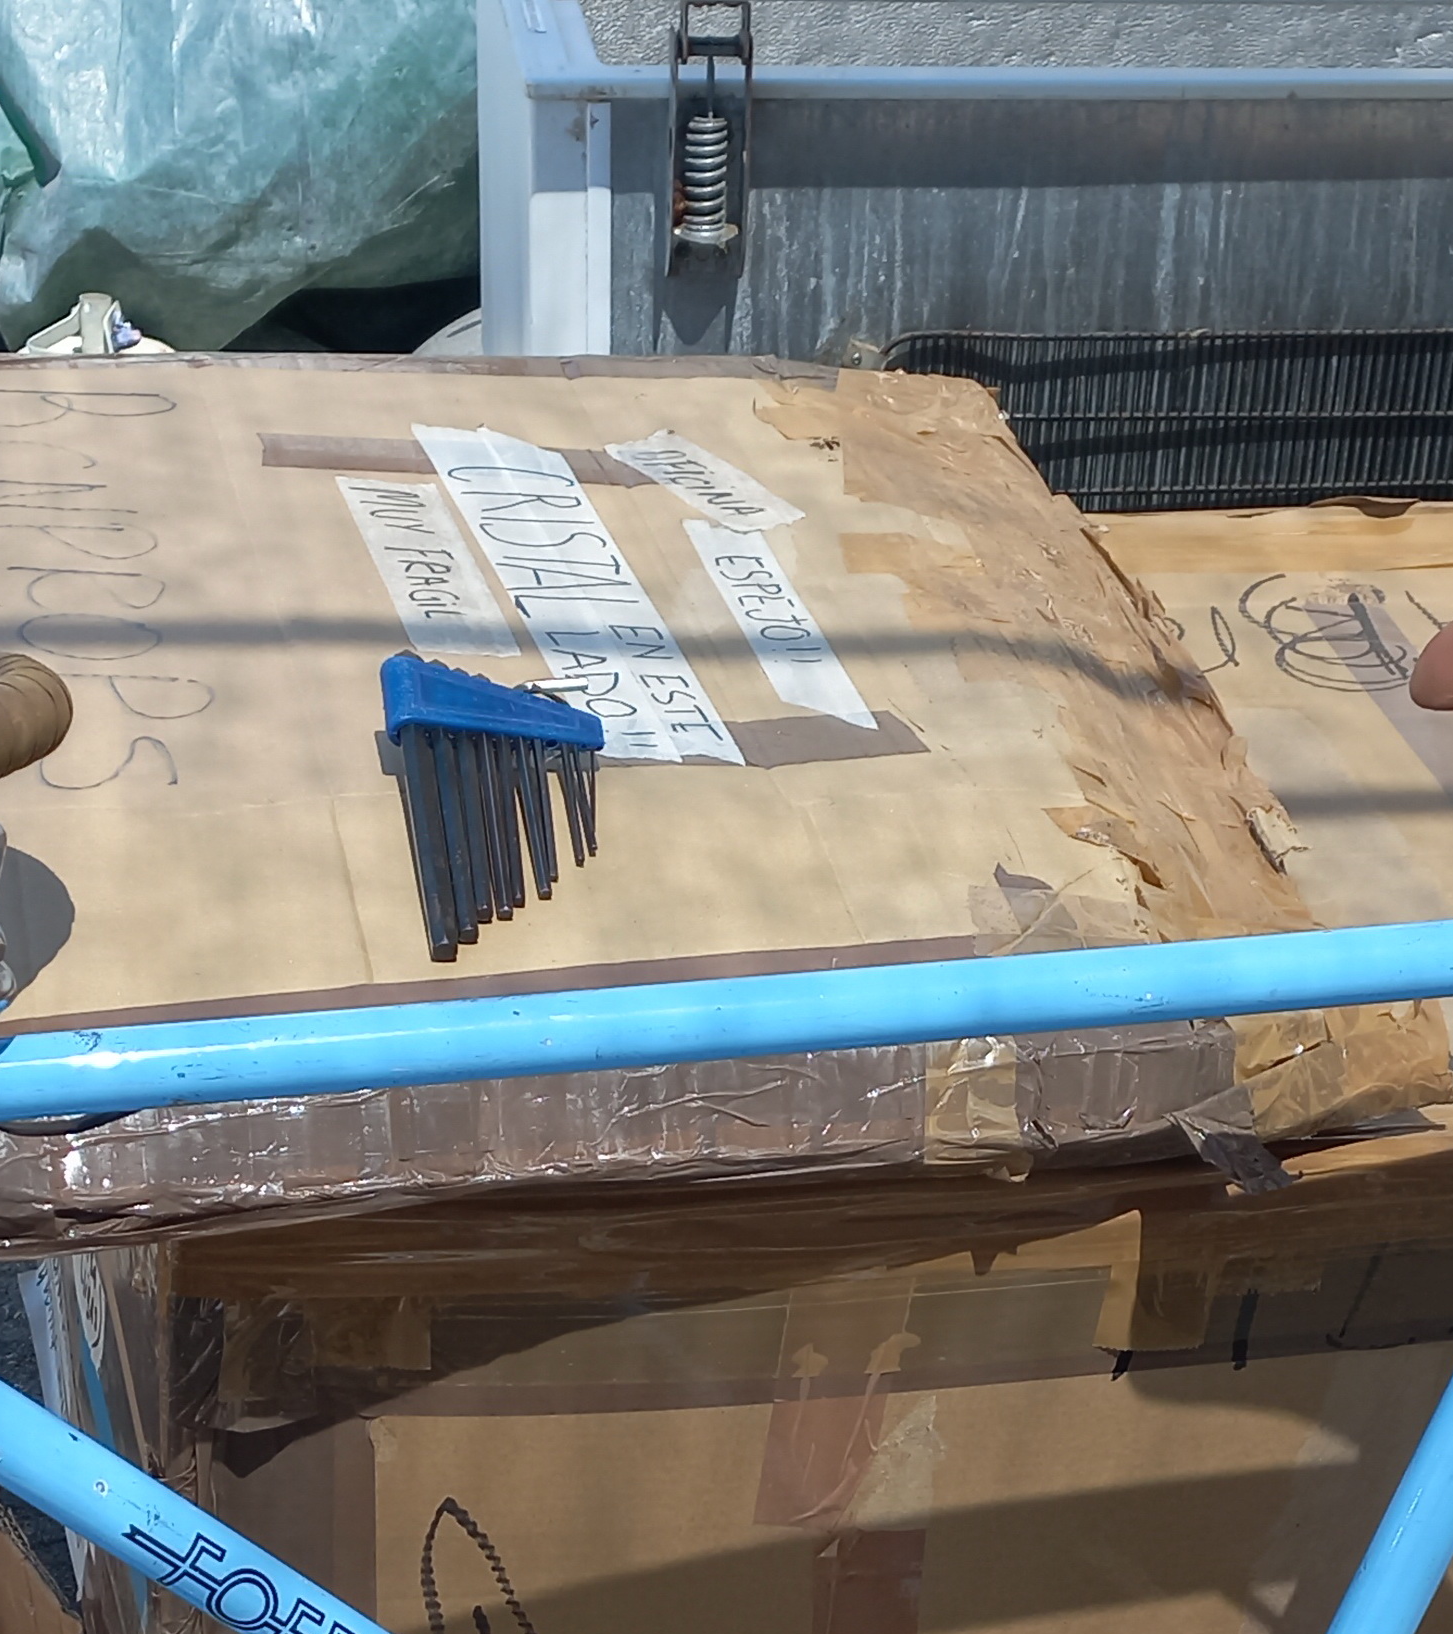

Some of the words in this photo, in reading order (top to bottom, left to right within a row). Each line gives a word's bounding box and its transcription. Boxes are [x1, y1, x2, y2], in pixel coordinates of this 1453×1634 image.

[348, 486, 436, 535] MUY
[447, 465, 640, 619] CRISTAL
[608, 624, 675, 661] EN
[638, 672, 725, 743] ESTE
